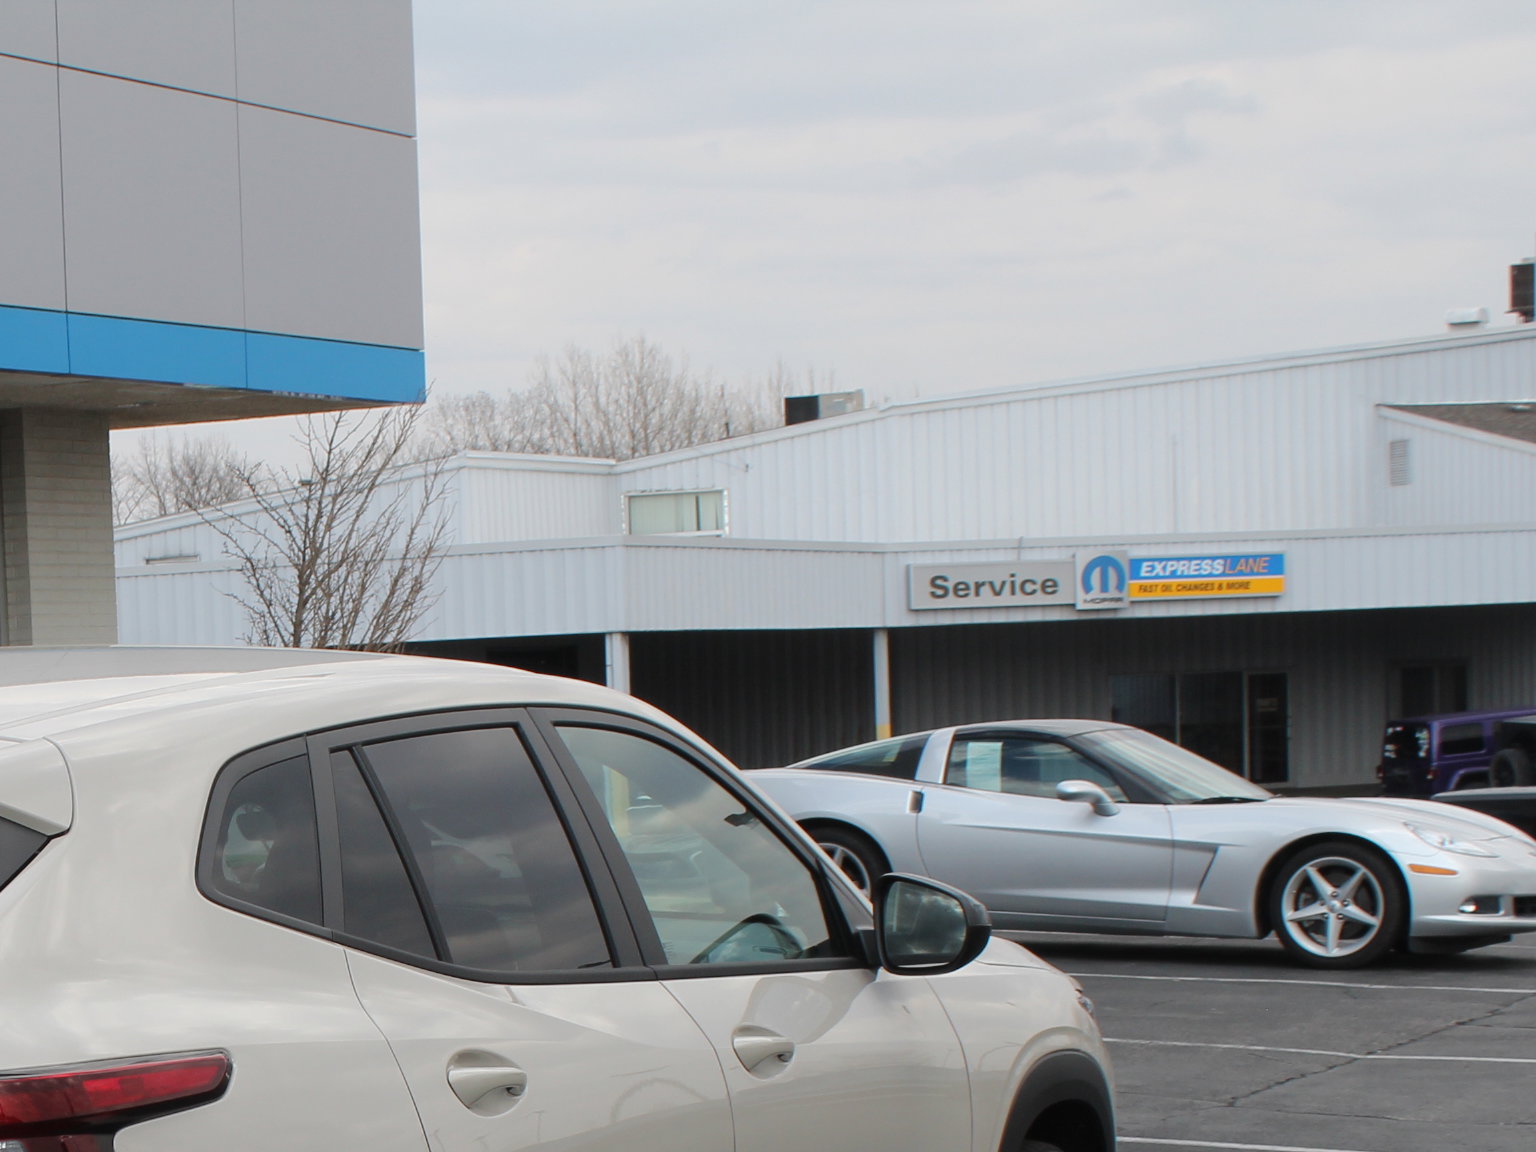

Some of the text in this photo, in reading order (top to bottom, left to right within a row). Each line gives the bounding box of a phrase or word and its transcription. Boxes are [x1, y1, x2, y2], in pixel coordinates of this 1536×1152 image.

[929, 573, 1059, 599] Service
[1138, 584, 1158, 593] FAST
[1161, 584, 1173, 592] OIL
[1175, 582, 1215, 592] CHANGES
[1226, 581, 1251, 590] MORE
